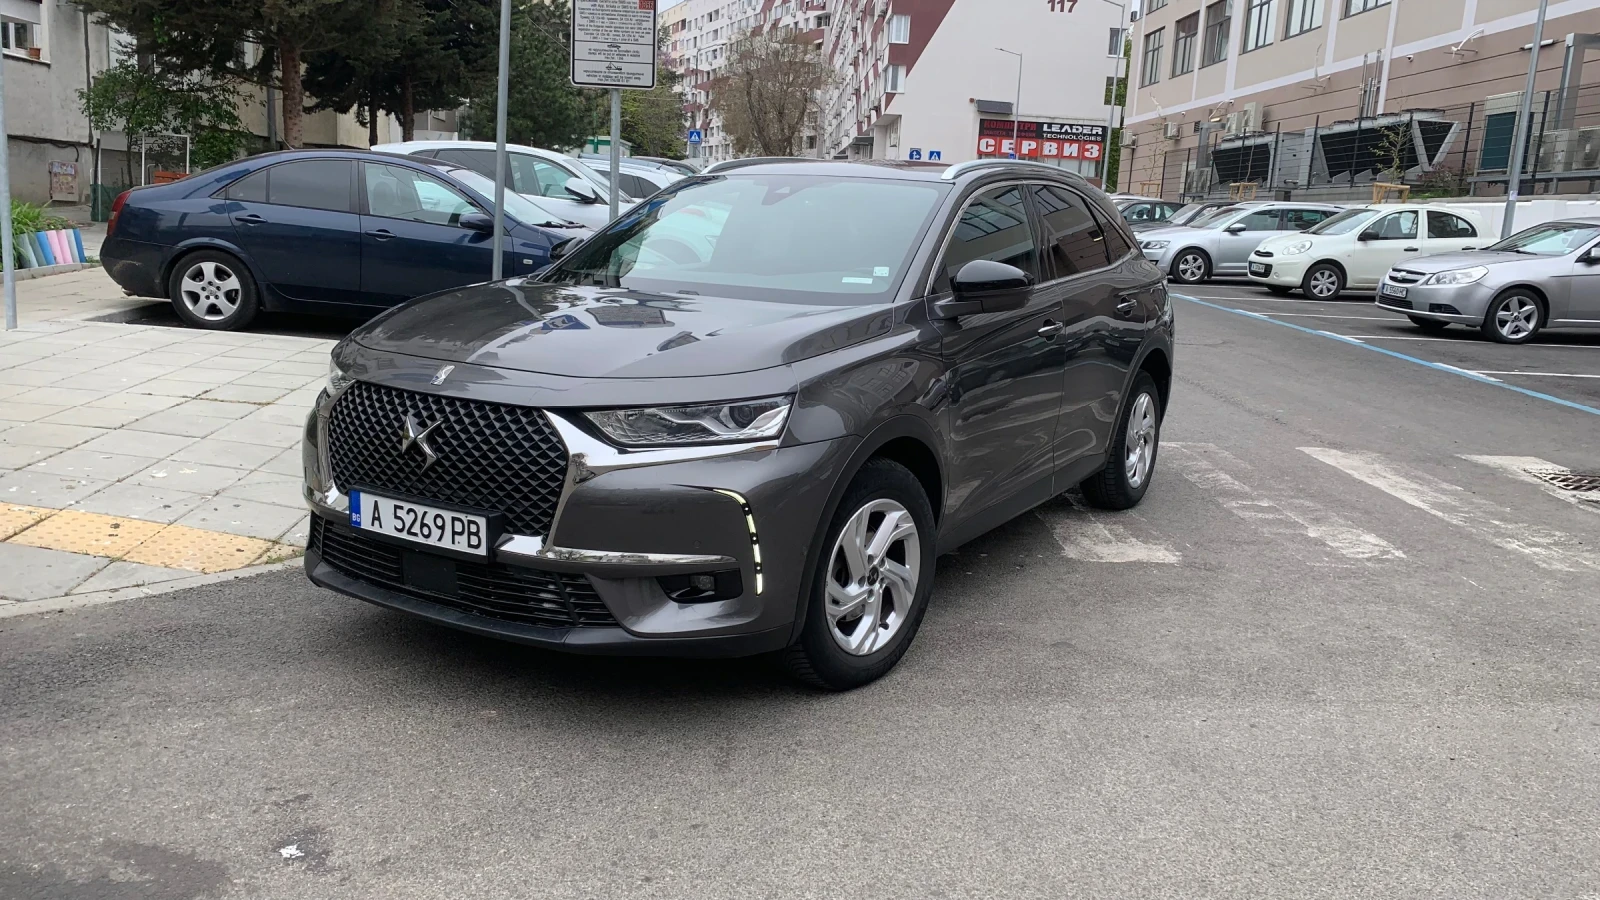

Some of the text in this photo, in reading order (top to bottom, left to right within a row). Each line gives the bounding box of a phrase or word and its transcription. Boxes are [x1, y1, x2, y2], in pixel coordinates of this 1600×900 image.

[1047, 0, 1079, 13] 117
[1042, 123, 1102, 135] LEADER
[1043, 133, 1102, 141] TECHNOLOGIES
[979, 138, 1100, 158] СЕРВИЗ
[352, 512, 361, 522] BG
[371, 499, 482, 550] A 5269 PB
